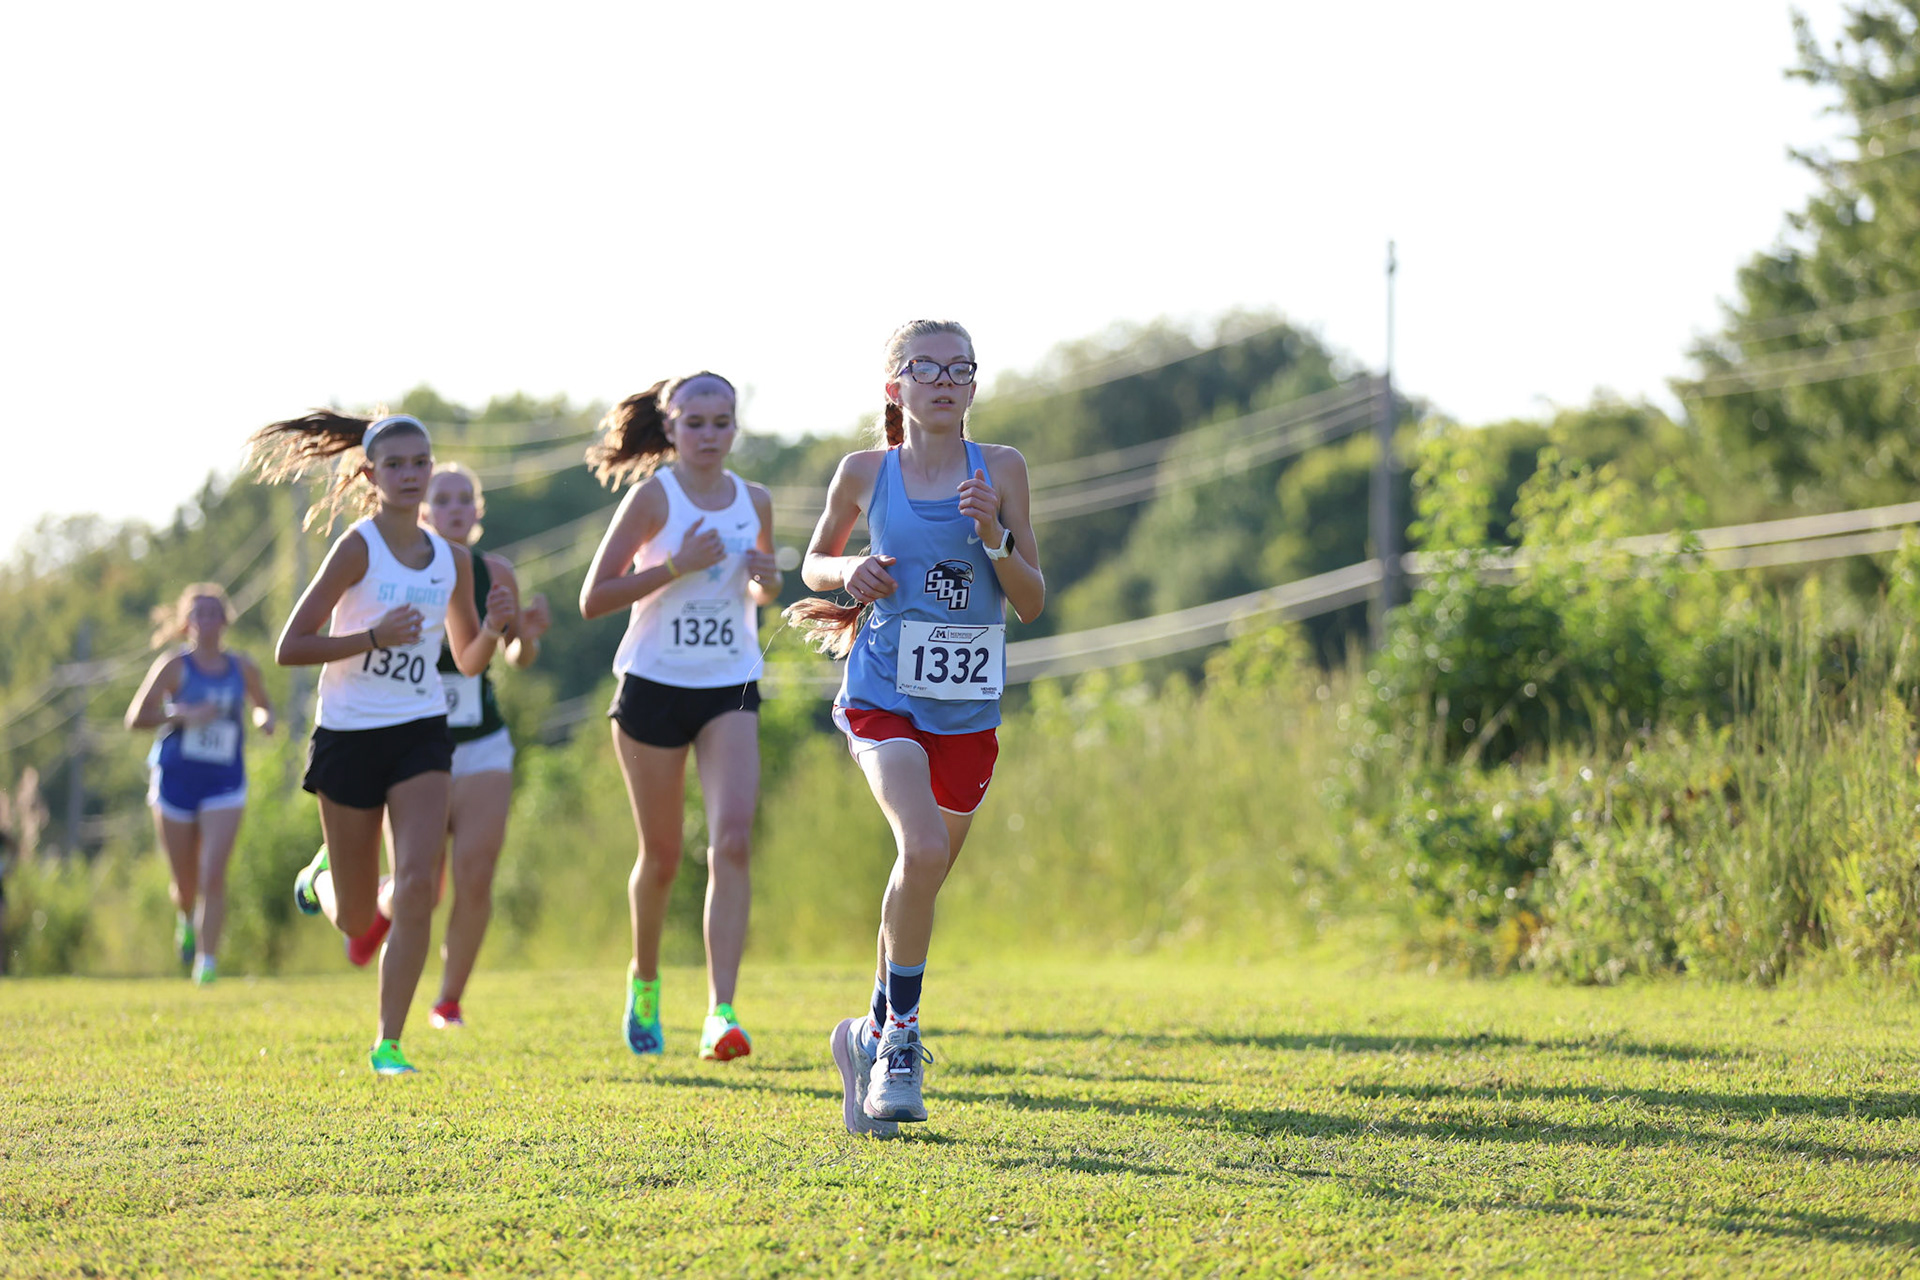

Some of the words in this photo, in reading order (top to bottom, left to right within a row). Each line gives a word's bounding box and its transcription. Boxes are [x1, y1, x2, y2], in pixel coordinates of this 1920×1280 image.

[926, 570, 968, 609] SBA
[672, 618, 734, 646] 1326
[934, 630, 947, 639] M
[362, 647, 425, 684] 1320
[912, 646, 989, 684] 1332
